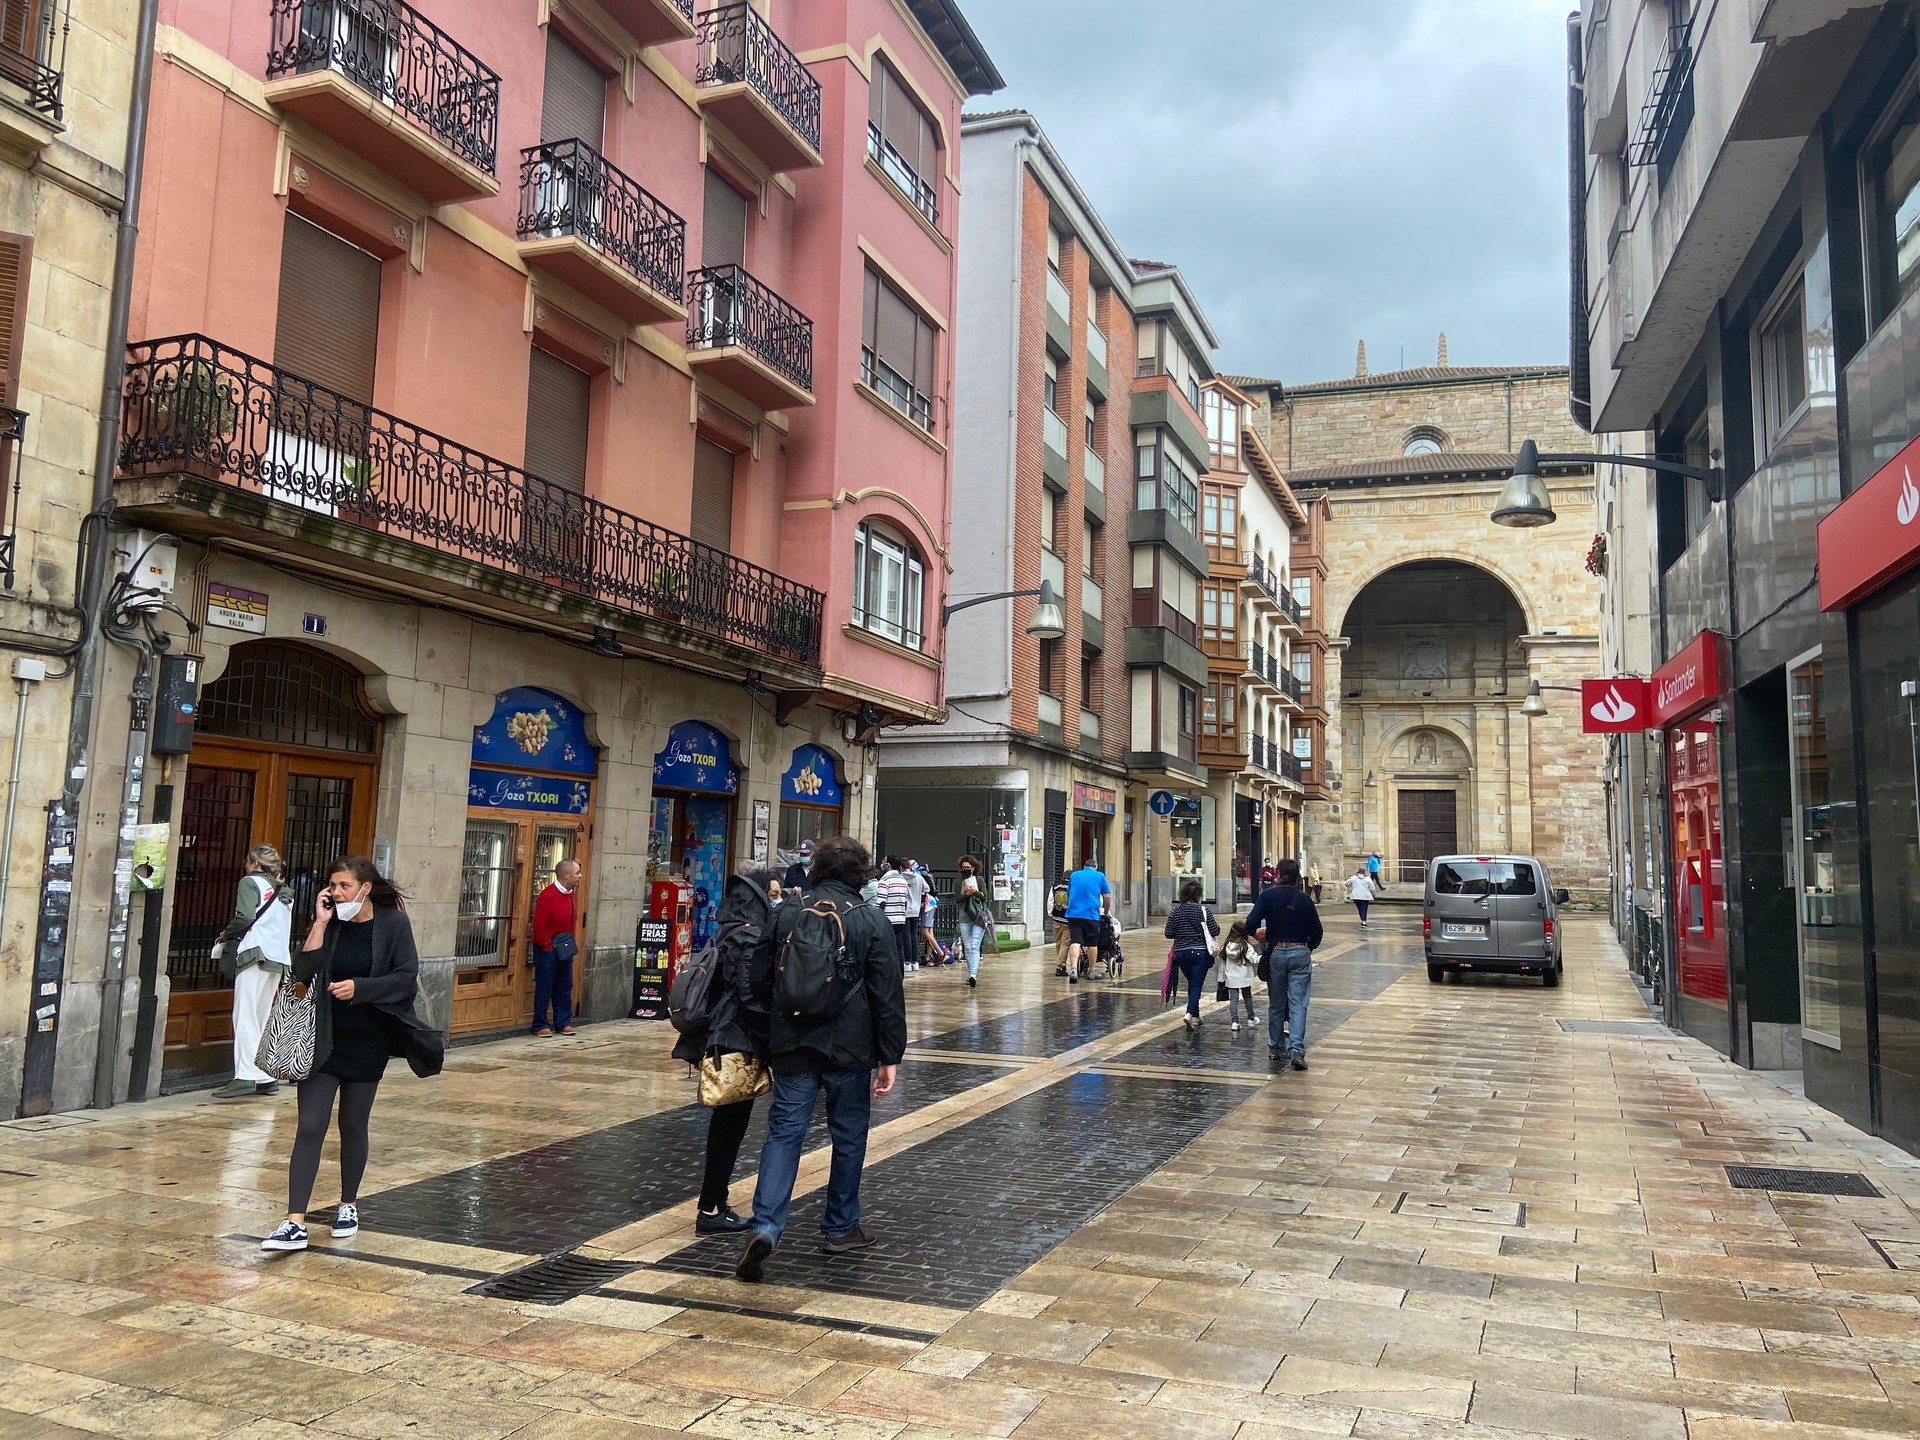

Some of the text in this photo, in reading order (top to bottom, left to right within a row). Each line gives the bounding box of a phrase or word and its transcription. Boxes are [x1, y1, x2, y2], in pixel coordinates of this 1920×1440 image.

[219, 610, 254, 622] ANDRA MARIA
[228, 619, 245, 628] KALEA
[312, 618, 318, 632] 1
[1664, 664, 1696, 705] Santander
[665, 740, 717, 767] Gozo TXORI
[488, 779, 559, 805] Gozo TXORI
[641, 929, 667, 938] FRÍAS
[1470, 925, 1483, 933] JFX
